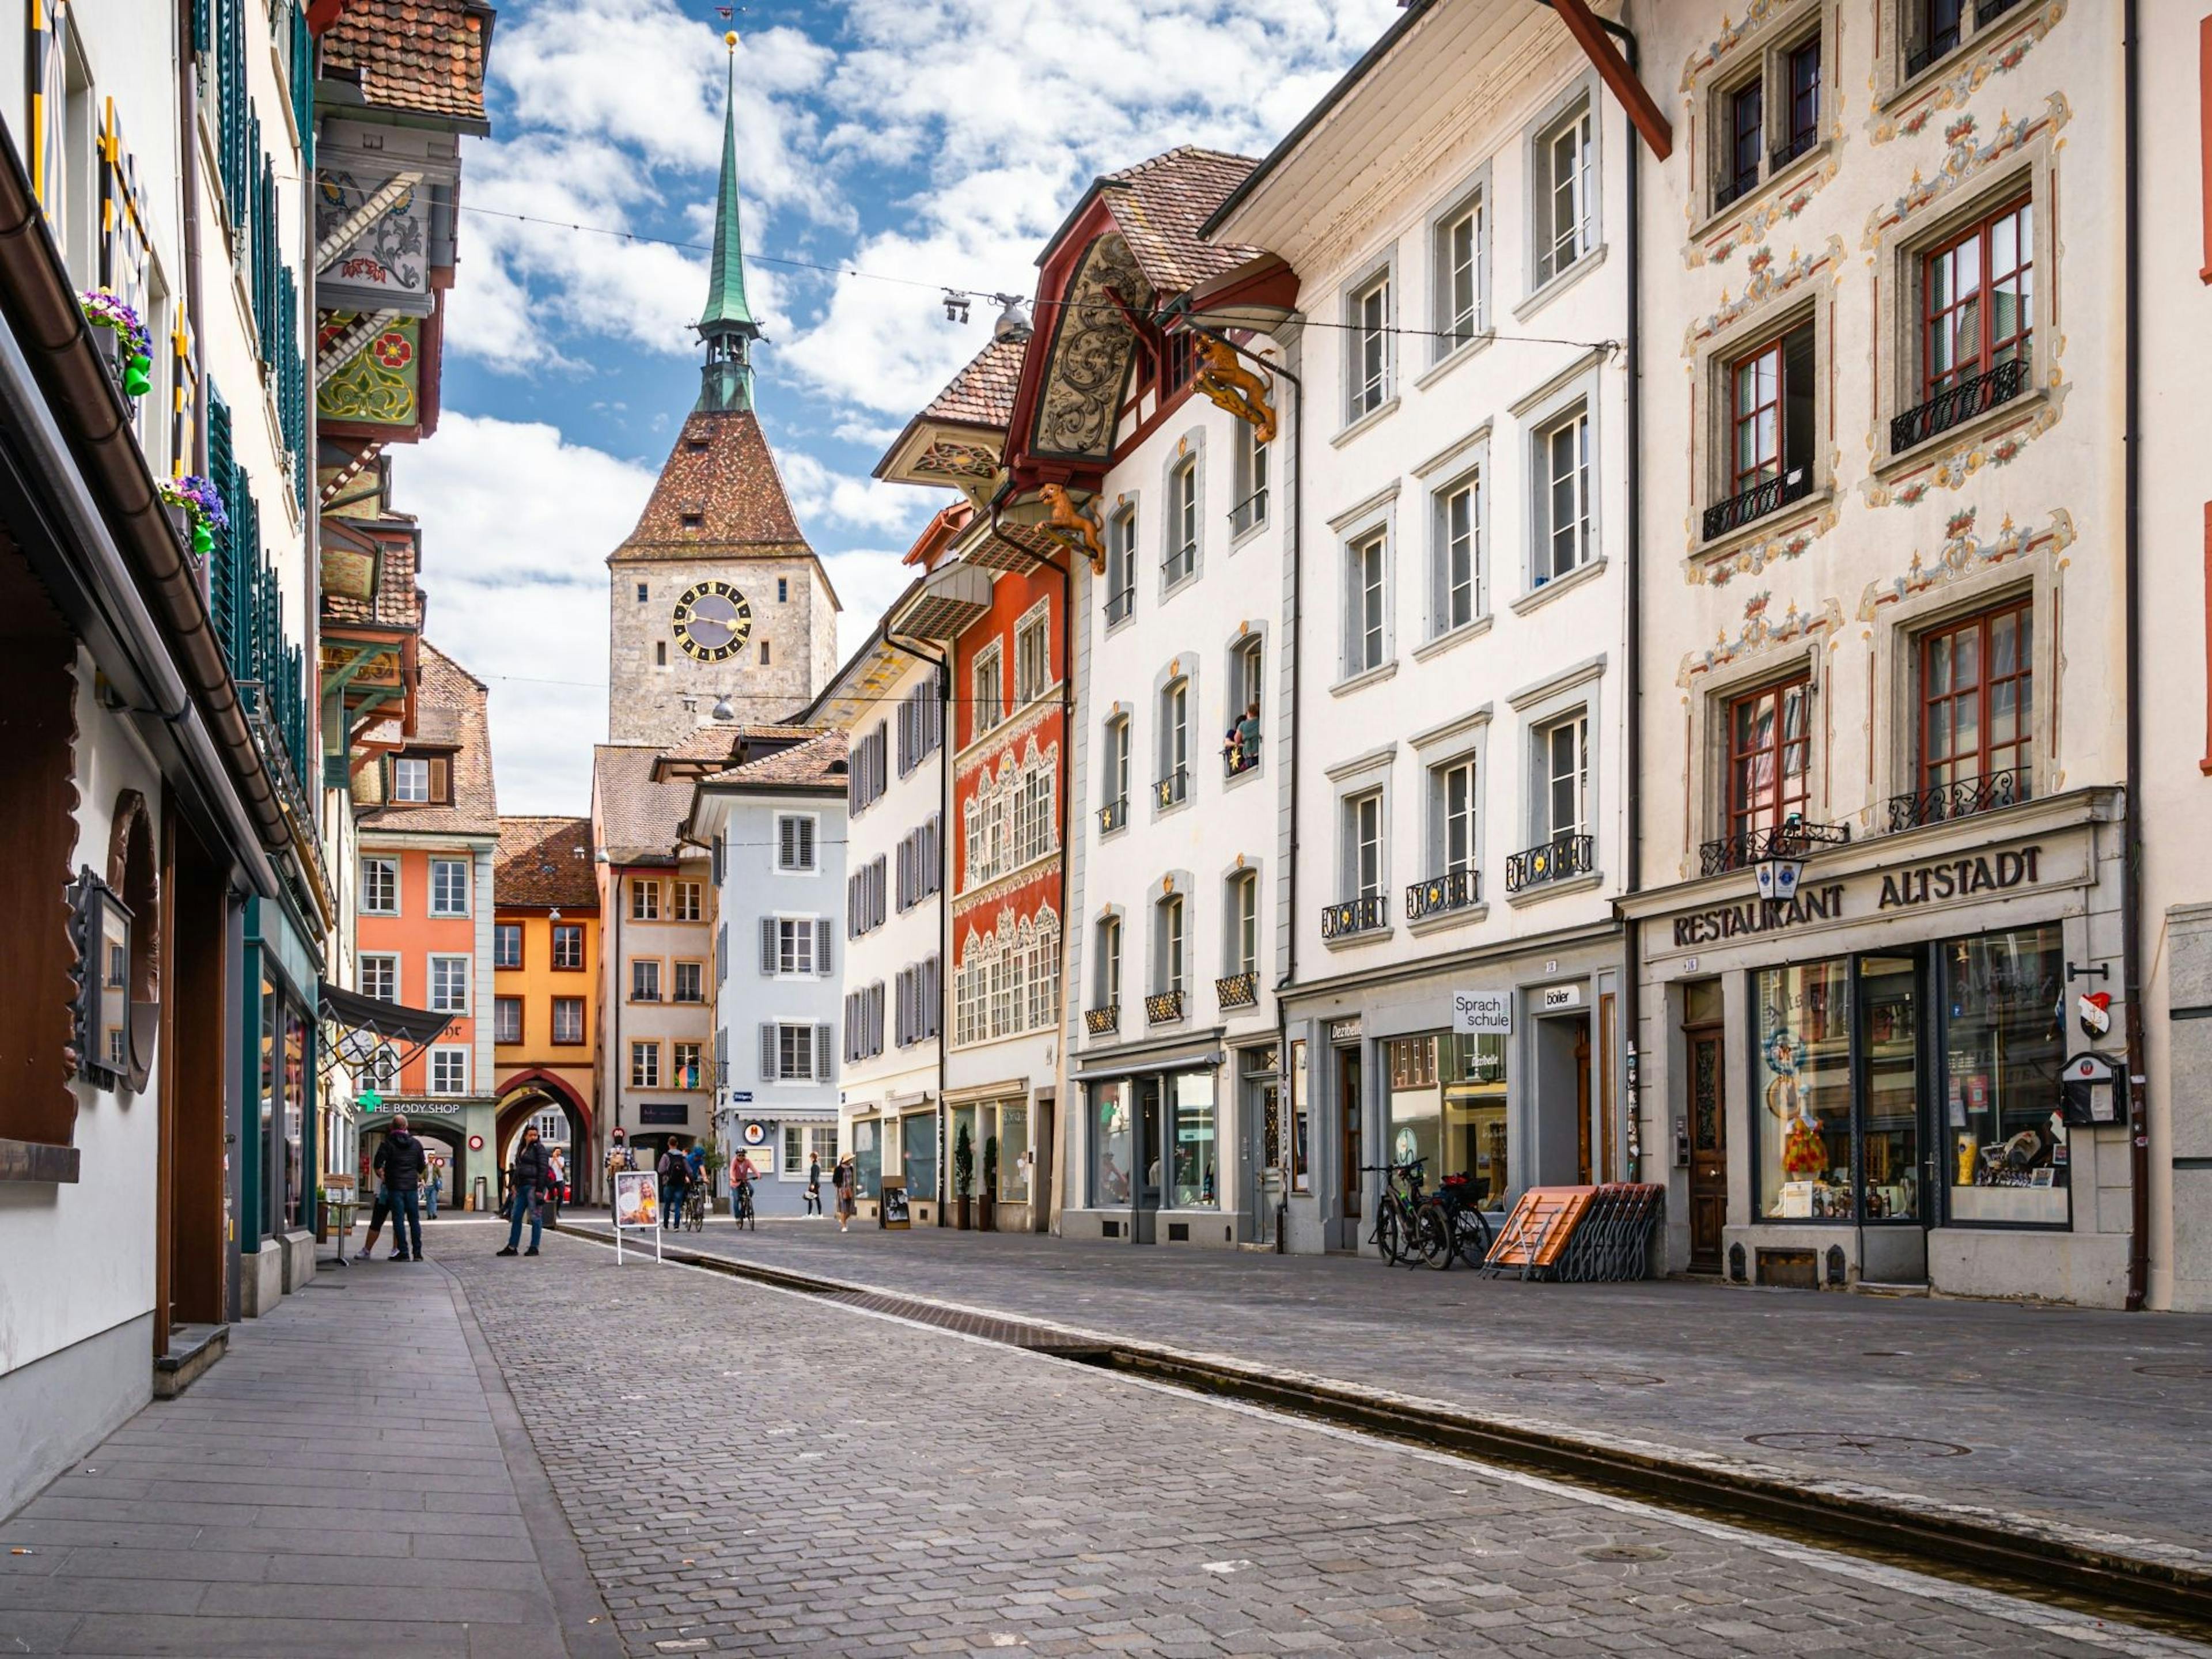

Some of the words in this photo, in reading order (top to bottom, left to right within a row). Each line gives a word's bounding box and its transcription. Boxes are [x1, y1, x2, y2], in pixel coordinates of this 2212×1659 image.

[1673, 884, 1844, 946] RESTAURANT
[1877, 846, 2041, 909] ALTSTADT
[1456, 997, 1500, 1014] Sprach
[1468, 1012, 1509, 1027] schule
[373, 1103, 390, 1113] HE
[394, 1103, 428, 1113] BODY
[429, 1104, 460, 1113] SHOP
